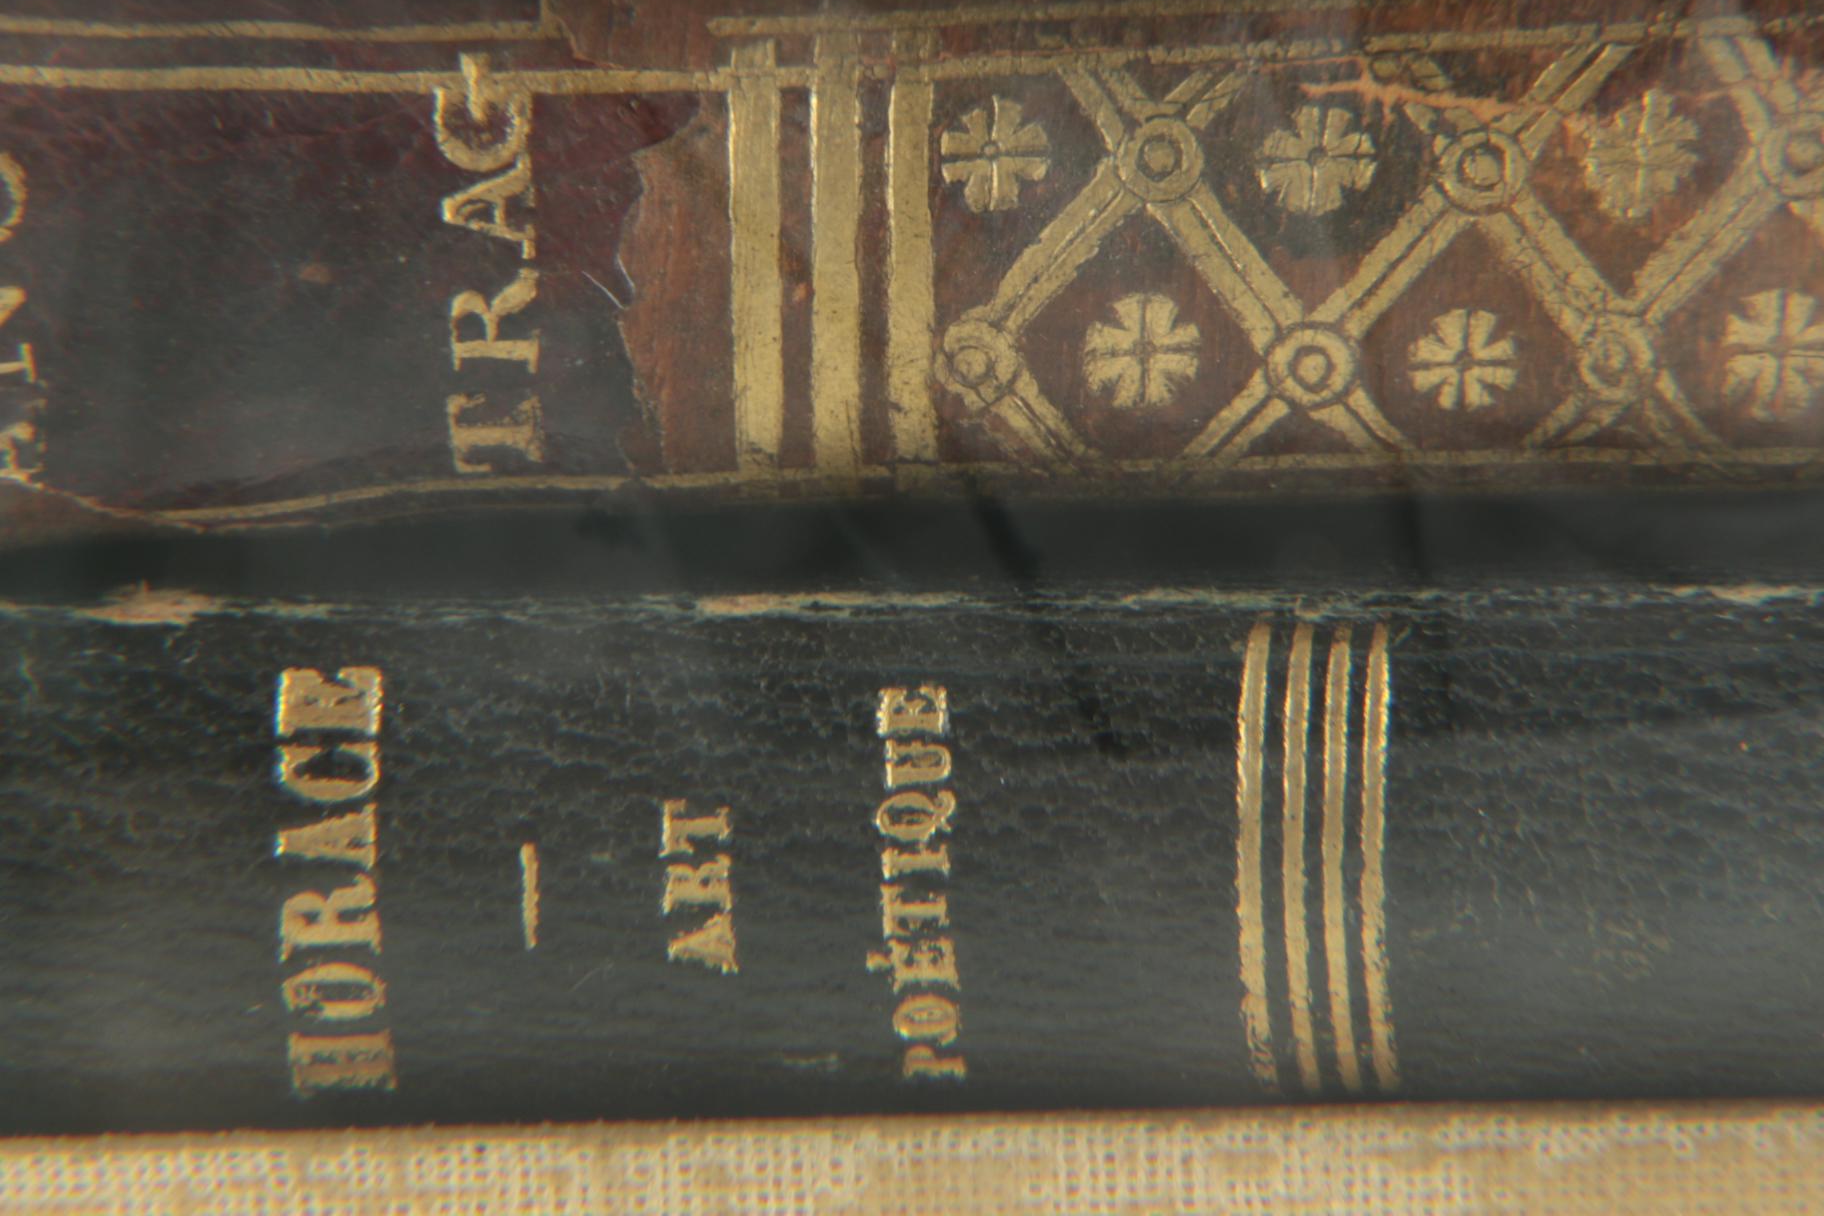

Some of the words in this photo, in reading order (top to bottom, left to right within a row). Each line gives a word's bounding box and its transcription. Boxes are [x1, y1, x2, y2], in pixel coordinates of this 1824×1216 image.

[433, 52, 544, 474] TRAG
[273, 666, 398, 1098] HORACE
[660, 798, 738, 974] ART
